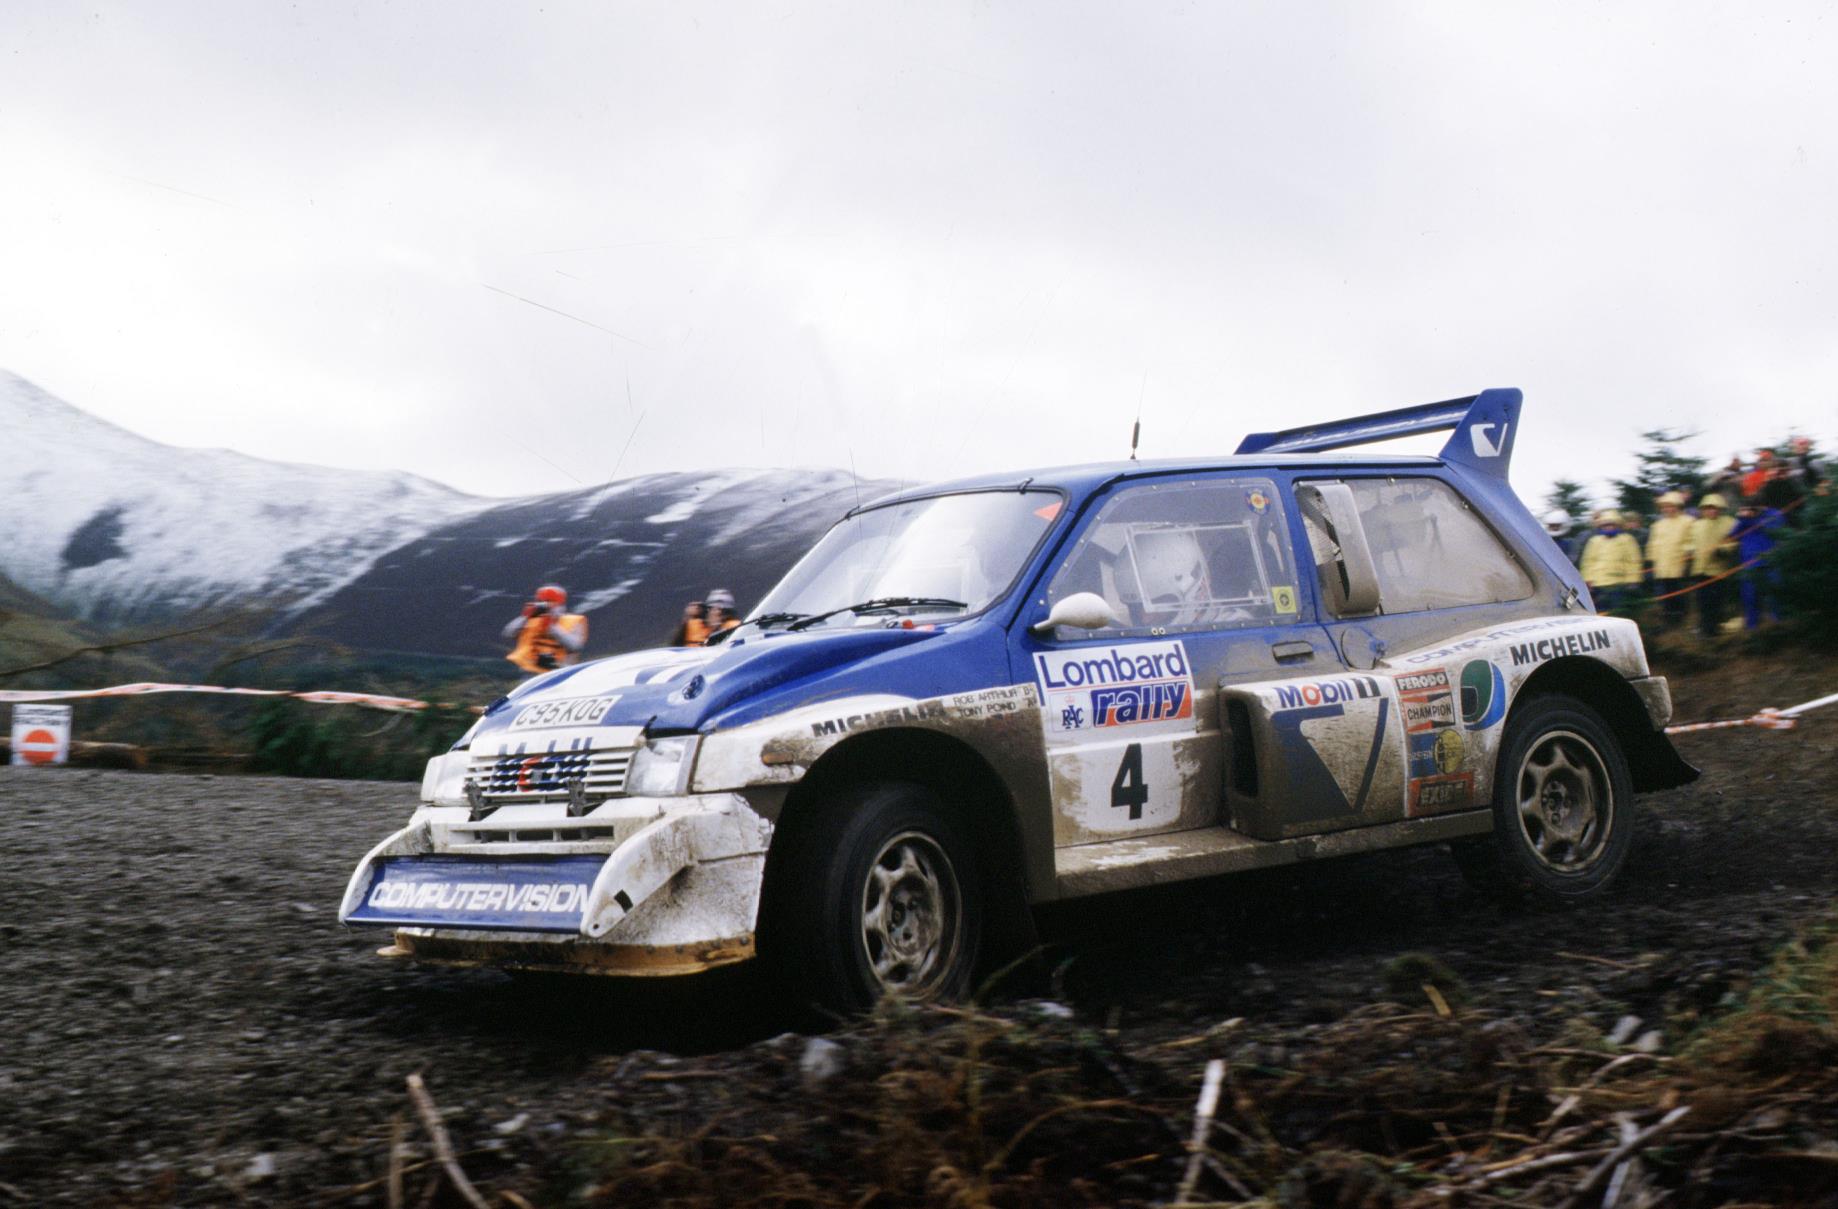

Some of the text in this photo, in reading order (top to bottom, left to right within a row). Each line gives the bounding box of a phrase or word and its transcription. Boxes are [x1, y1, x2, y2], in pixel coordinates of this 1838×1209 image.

[1509, 629, 1611, 666] MICHELIN
[1038, 643, 1187, 688] Lombard
[1397, 672, 1447, 690] FERODO
[959, 705, 983, 718] TONY
[986, 701, 1017, 713] POND
[1095, 681, 1188, 727] rally
[1273, 680, 1354, 708] Mobil
[1407, 703, 1452, 720] CHAMPION
[1111, 742, 1149, 820] 4
[367, 881, 590, 913] COMPUTERVISION
